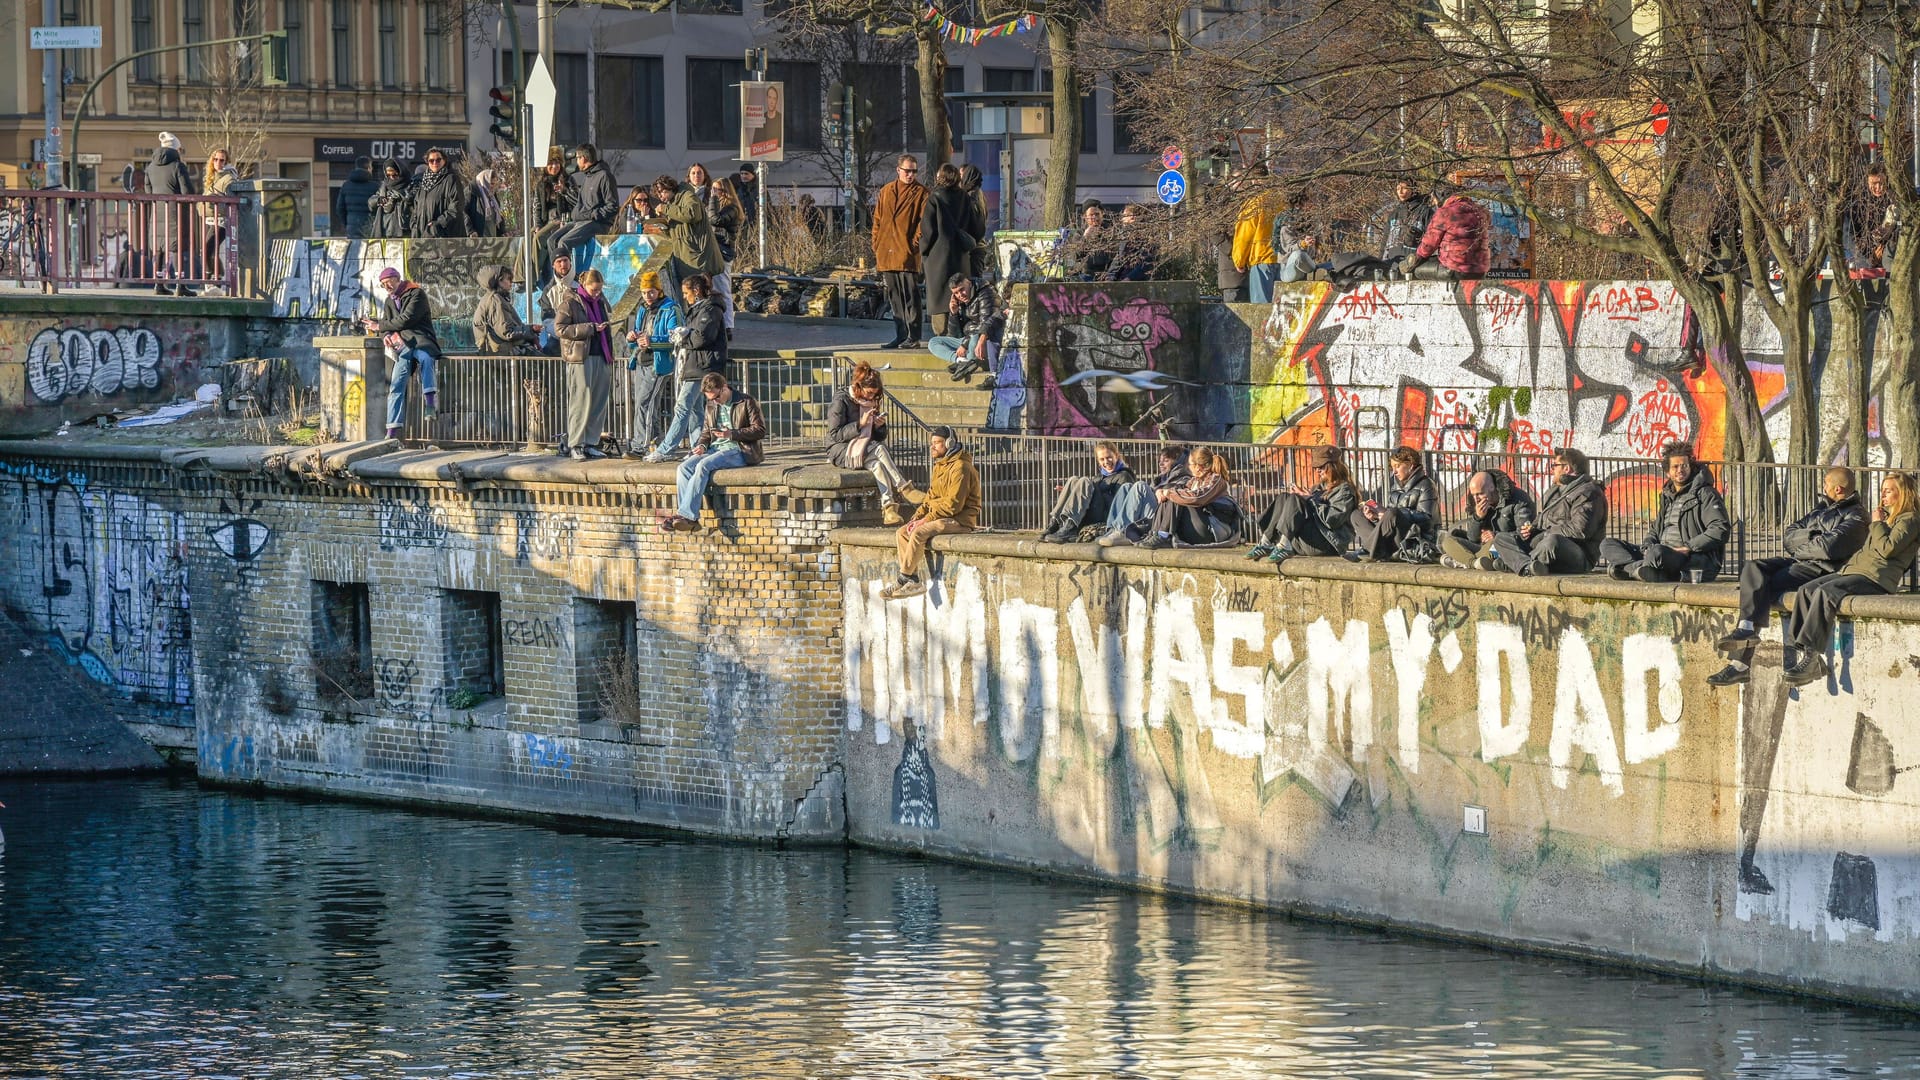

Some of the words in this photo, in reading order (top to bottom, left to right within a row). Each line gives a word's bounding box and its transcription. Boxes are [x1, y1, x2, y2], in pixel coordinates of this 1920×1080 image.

[371, 141, 395, 159] CUT
[398, 141, 416, 159] 36
[752, 146, 763, 154] Die
[1476, 618, 1685, 798] DAD
